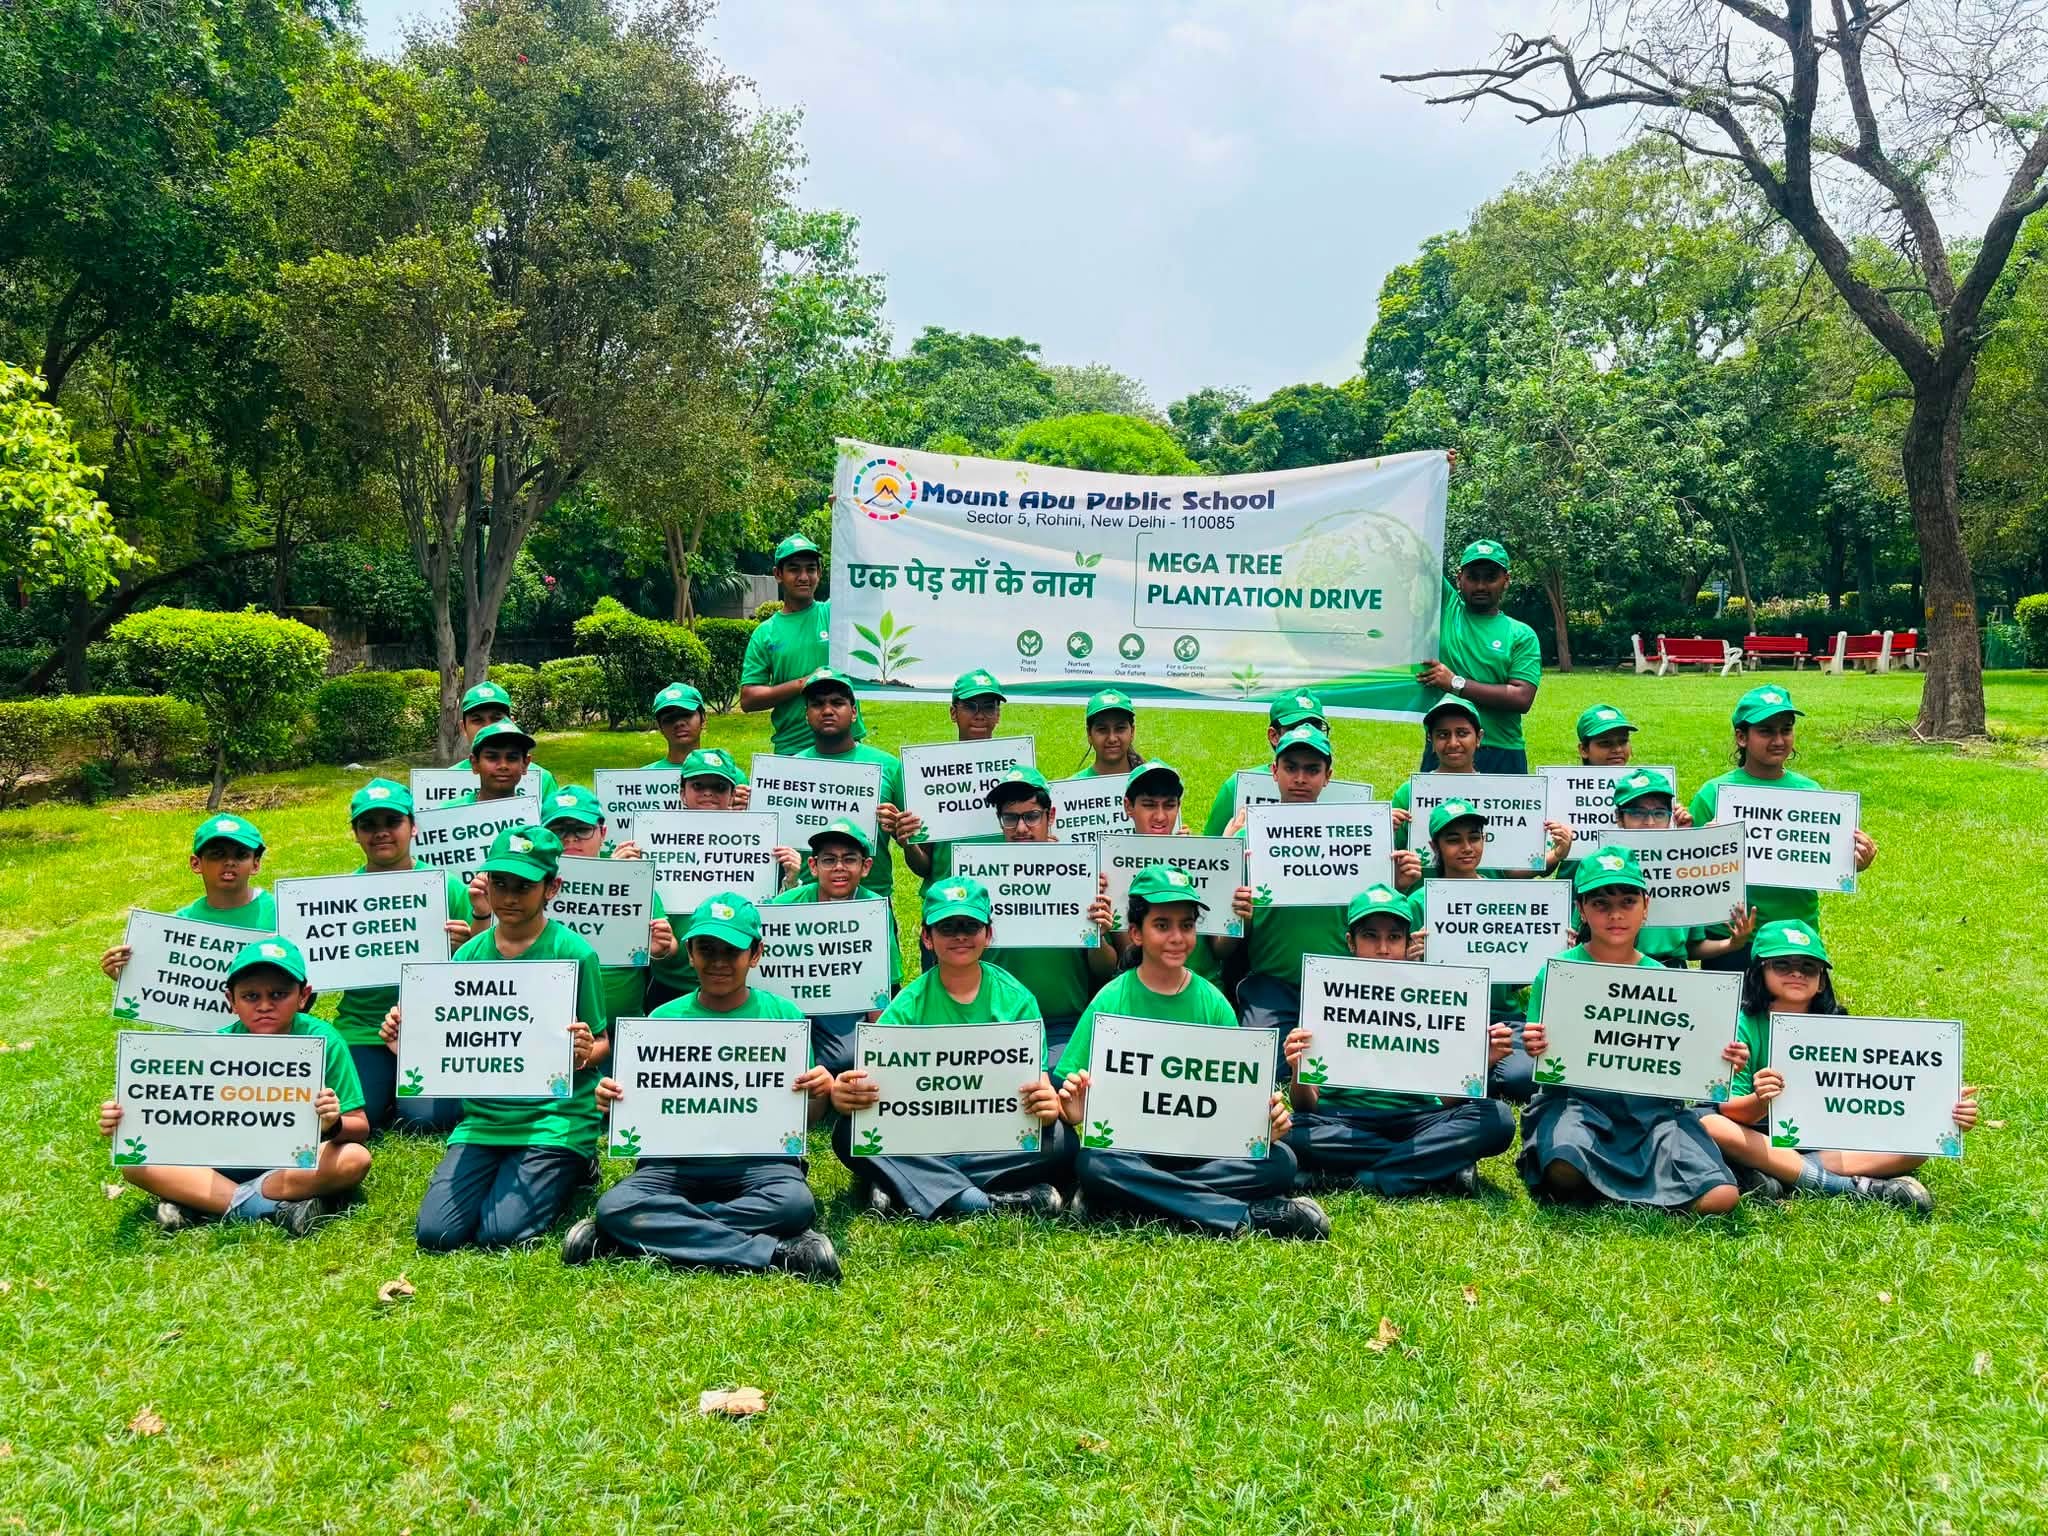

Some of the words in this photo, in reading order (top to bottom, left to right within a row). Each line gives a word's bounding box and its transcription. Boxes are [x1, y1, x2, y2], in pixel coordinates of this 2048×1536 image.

[922, 481, 1008, 507] Mount
[1018, 491, 1076, 510] Abu
[1087, 492, 1172, 510] Public
[1182, 490, 1275, 510] School
[967, 510, 1013, 524] Sector
[1018, 513, 1030, 527] 5,
[1036, 513, 1085, 527] Rohini,
[1091, 514, 1123, 528] New
[1128, 516, 1166, 528] Delhi
[1182, 516, 1234, 530] 110085
[1148, 552, 1220, 574] MEGA
[1226, 554, 1282, 574] TREE
[848, 564, 899, 590] एक
[904, 558, 944, 600] पेड़
[950, 558, 992, 594] माँ
[994, 562, 1026, 595] के
[1031, 571, 1096, 598] नाम
[1148, 584, 1302, 608] PLANTATION
[1310, 588, 1382, 610] DRIVE
[921, 763, 973, 778] WHERE
[616, 784, 642, 795] THE
[645, 784, 678, 795] WOR
[756, 778, 780, 790] THE
[784, 780, 815, 792] BEST
[819, 783, 874, 798] STORIES
[924, 781, 976, 796] GROW,
[980, 779, 1000, 792] HO
[1567, 778, 1594, 790] THE
[426, 788, 457, 800] LIFE
[1576, 796, 1615, 806] BLOO
[608, 801, 660, 812] GROWS
[768, 795, 807, 808] BEGIN
[811, 798, 847, 812] WITH
[850, 802, 860, 812] A
[938, 798, 996, 813] FOLLOW
[1064, 796, 1111, 812] WHERE
[1484, 798, 1542, 810] STORIES
[796, 814, 828, 826] SEED
[1056, 814, 1110, 829] DEEPEN,
[1517, 816, 1527, 826] A
[1568, 813, 1617, 824] THROU
[1733, 805, 1782, 821] THINK
[1787, 809, 1841, 826] GREEN
[415, 829, 448, 846] LIFE
[651, 833, 704, 846] WHERE
[708, 834, 760, 846] ROOTS
[1266, 826, 1322, 838] WHERE
[1326, 825, 1372, 838] TREES
[1571, 830, 1598, 841] OUR
[1776, 828, 1830, 844] GREEN
[704, 852, 770, 864] FUTURES
[1269, 845, 1324, 859] GROW,
[1329, 844, 1372, 856] HOPE
[1635, 850, 1662, 861] EEN
[1666, 842, 1738, 862] CHOICES
[1748, 846, 1772, 860] IVE
[1776, 849, 1831, 865] GREEN
[655, 870, 754, 882] STRENGTHEN
[959, 864, 1010, 876] PLANT
[1013, 864, 1092, 878] PURPOSE,
[1284, 864, 1359, 876] FOLLOWS
[1643, 868, 1672, 880] ATE
[1676, 860, 1740, 879] GOLDEN
[561, 880, 604, 896] REEN
[608, 884, 630, 896] BE
[999, 884, 1050, 896] GROW
[1647, 881, 1730, 898] MORROWS
[297, 899, 358, 917] THINK
[363, 894, 427, 912] GREEN
[553, 900, 642, 916] GREATEST
[990, 903, 1080, 916] SSIBILITIES
[1448, 903, 1472, 914] LET
[1476, 903, 1526, 915] GREEN
[1530, 904, 1548, 915] BE
[306, 922, 347, 939] ACT
[352, 917, 416, 934] GREEN
[564, 922, 604, 935] ACY
[760, 924, 790, 936] THE
[796, 920, 860, 936] WORLD
[1434, 922, 1478, 934] YOUR
[1482, 922, 1560, 934] GREATEST
[164, 930, 196, 947] THE
[200, 936, 252, 953] EART
[762, 944, 814, 957] ROWS
[818, 940, 872, 956] WISER
[1468, 941, 1528, 953] LEGACY
[310, 946, 350, 962] LIVE
[354, 940, 419, 958] GREEN
[169, 951, 232, 973] BLOOM
[760, 965, 804, 978] WITH
[808, 961, 862, 978] EVERY
[158, 970, 229, 992] THROUG
[454, 980, 517, 996] SMALL
[791, 984, 831, 998] TREE
[1324, 982, 1395, 1002] WHERE
[1400, 988, 1468, 1007] GREEN
[1608, 983, 1678, 1003] SMALL
[142, 988, 190, 1008] YOUR
[193, 997, 232, 1014] HAN
[434, 1006, 534, 1024] SAPLINGS,
[1324, 1006, 1422, 1030] REMAINS,
[1428, 1014, 1466, 1032] LIFE
[1584, 1004, 1695, 1031] SAPLINGS,
[446, 1032, 522, 1047] MIGHTY
[1346, 1032, 1440, 1054] REMAINS
[1594, 1030, 1680, 1051] MIGHTY
[637, 1046, 712, 1062] WHERE
[718, 1046, 786, 1062] GREEN
[864, 1051, 931, 1067] PLANT
[936, 1048, 1034, 1066] PURPOSE,
[1789, 1045, 1856, 1063] GREEN
[1862, 1048, 1942, 1067] SPEAKS
[130, 1059, 204, 1074] GREEN
[210, 1060, 311, 1077] CHOICES
[442, 1057, 524, 1073] FUTURES
[1106, 1049, 1154, 1076] LET
[1161, 1056, 1259, 1084] GREEN
[1587, 1052, 1682, 1076] FUTURES
[636, 1072, 740, 1090] REMAINS,
[746, 1072, 784, 1088] LIFE
[916, 1075, 984, 1092] GROW
[1815, 1071, 1916, 1091] WITHOUT
[128, 1084, 214, 1100] CREATE
[220, 1086, 312, 1102] GOLDEN
[662, 1098, 758, 1114] REMAINS
[878, 1098, 1018, 1116] POSSIBILITIES
[1142, 1092, 1217, 1118] LEAD
[1824, 1097, 1905, 1116] WORDS
[142, 1109, 296, 1127] TOMORROWS
